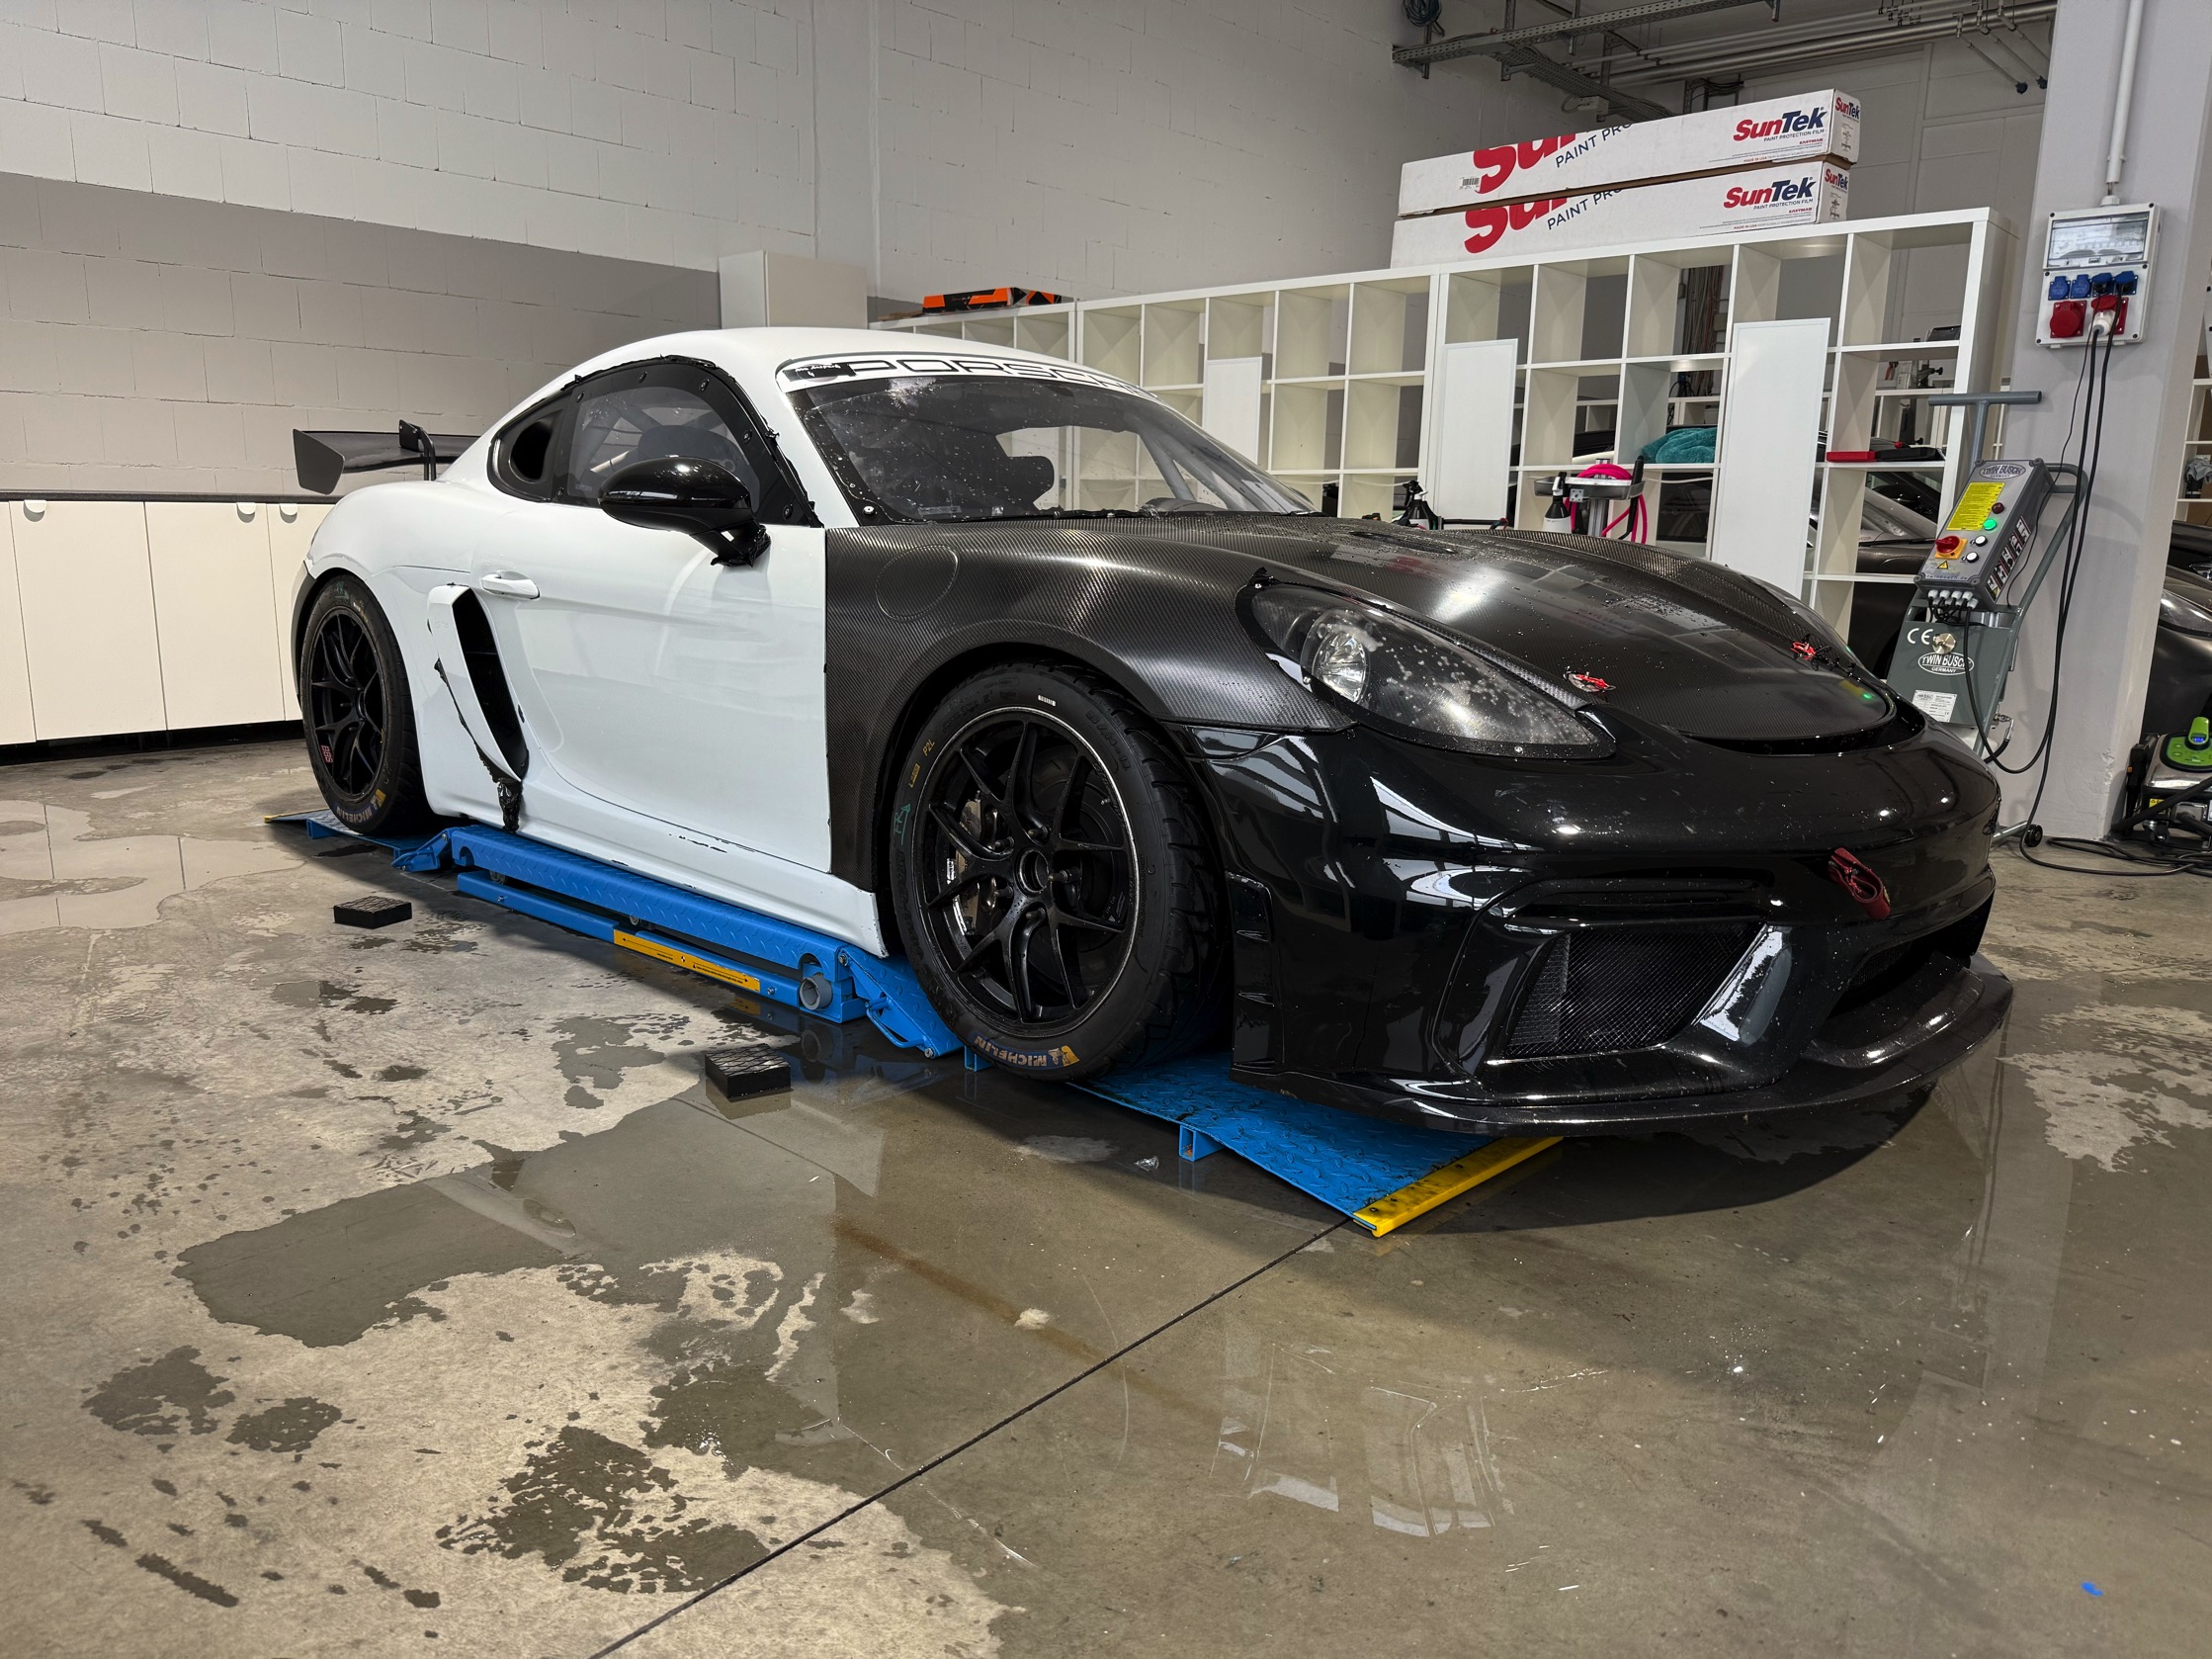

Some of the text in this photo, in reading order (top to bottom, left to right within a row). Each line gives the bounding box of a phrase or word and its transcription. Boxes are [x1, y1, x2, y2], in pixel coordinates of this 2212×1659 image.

[1834, 97, 1860, 120] SunTek
[1779, 131, 1812, 140] PROTECTION
[1555, 134, 1597, 168] PAINT
[1825, 168, 1848, 191] SunTek
[1547, 198, 1588, 230] PAINT
[1769, 199, 1801, 209] PROTECTION
[1921, 654, 1965, 668] TWIN BUSC
[336, 806, 373, 824] MICHELIN
[974, 1035, 1048, 1067] MICHELIN
